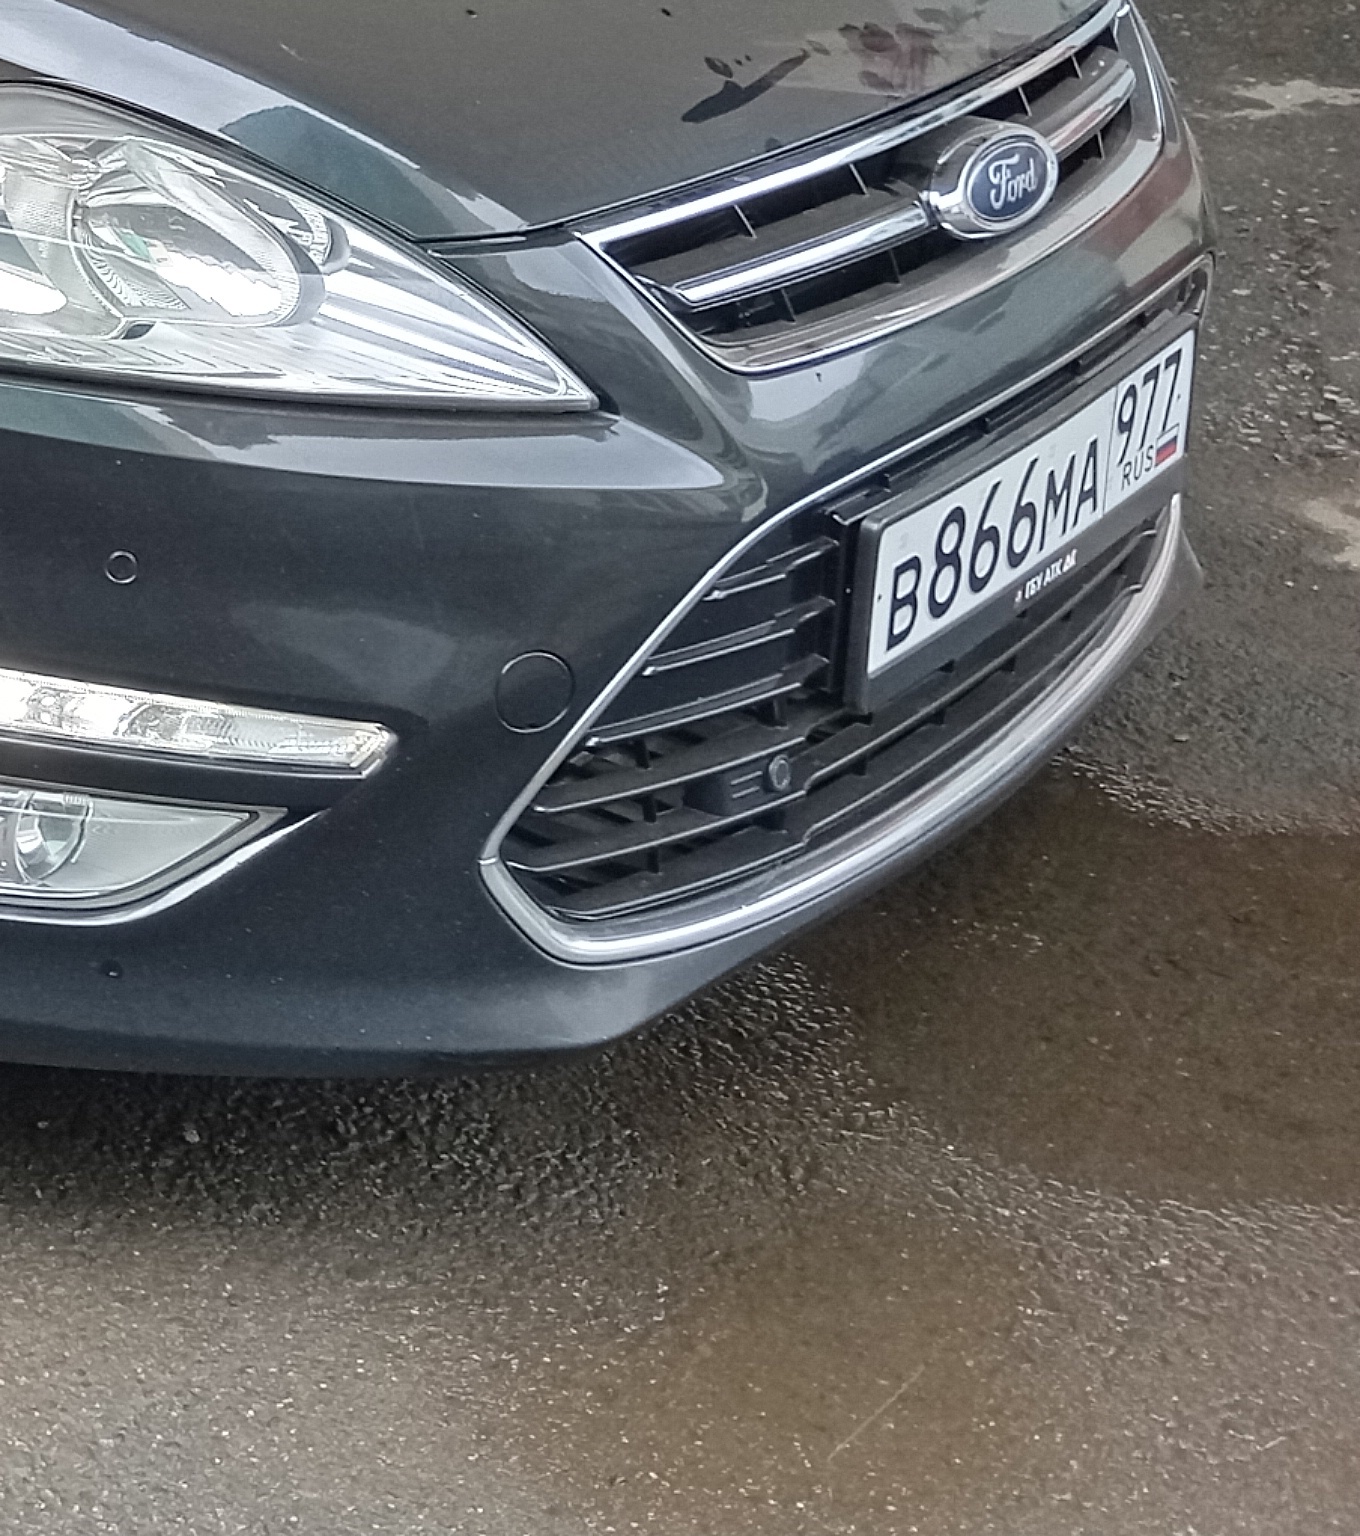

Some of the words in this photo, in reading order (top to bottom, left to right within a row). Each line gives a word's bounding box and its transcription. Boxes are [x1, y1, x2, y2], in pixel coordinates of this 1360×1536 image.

[988, 153, 1039, 210] Ford
[1120, 444, 1154, 492] RUS
[886, 434, 1099, 653] В866МА
[1117, 347, 1182, 468] 977
